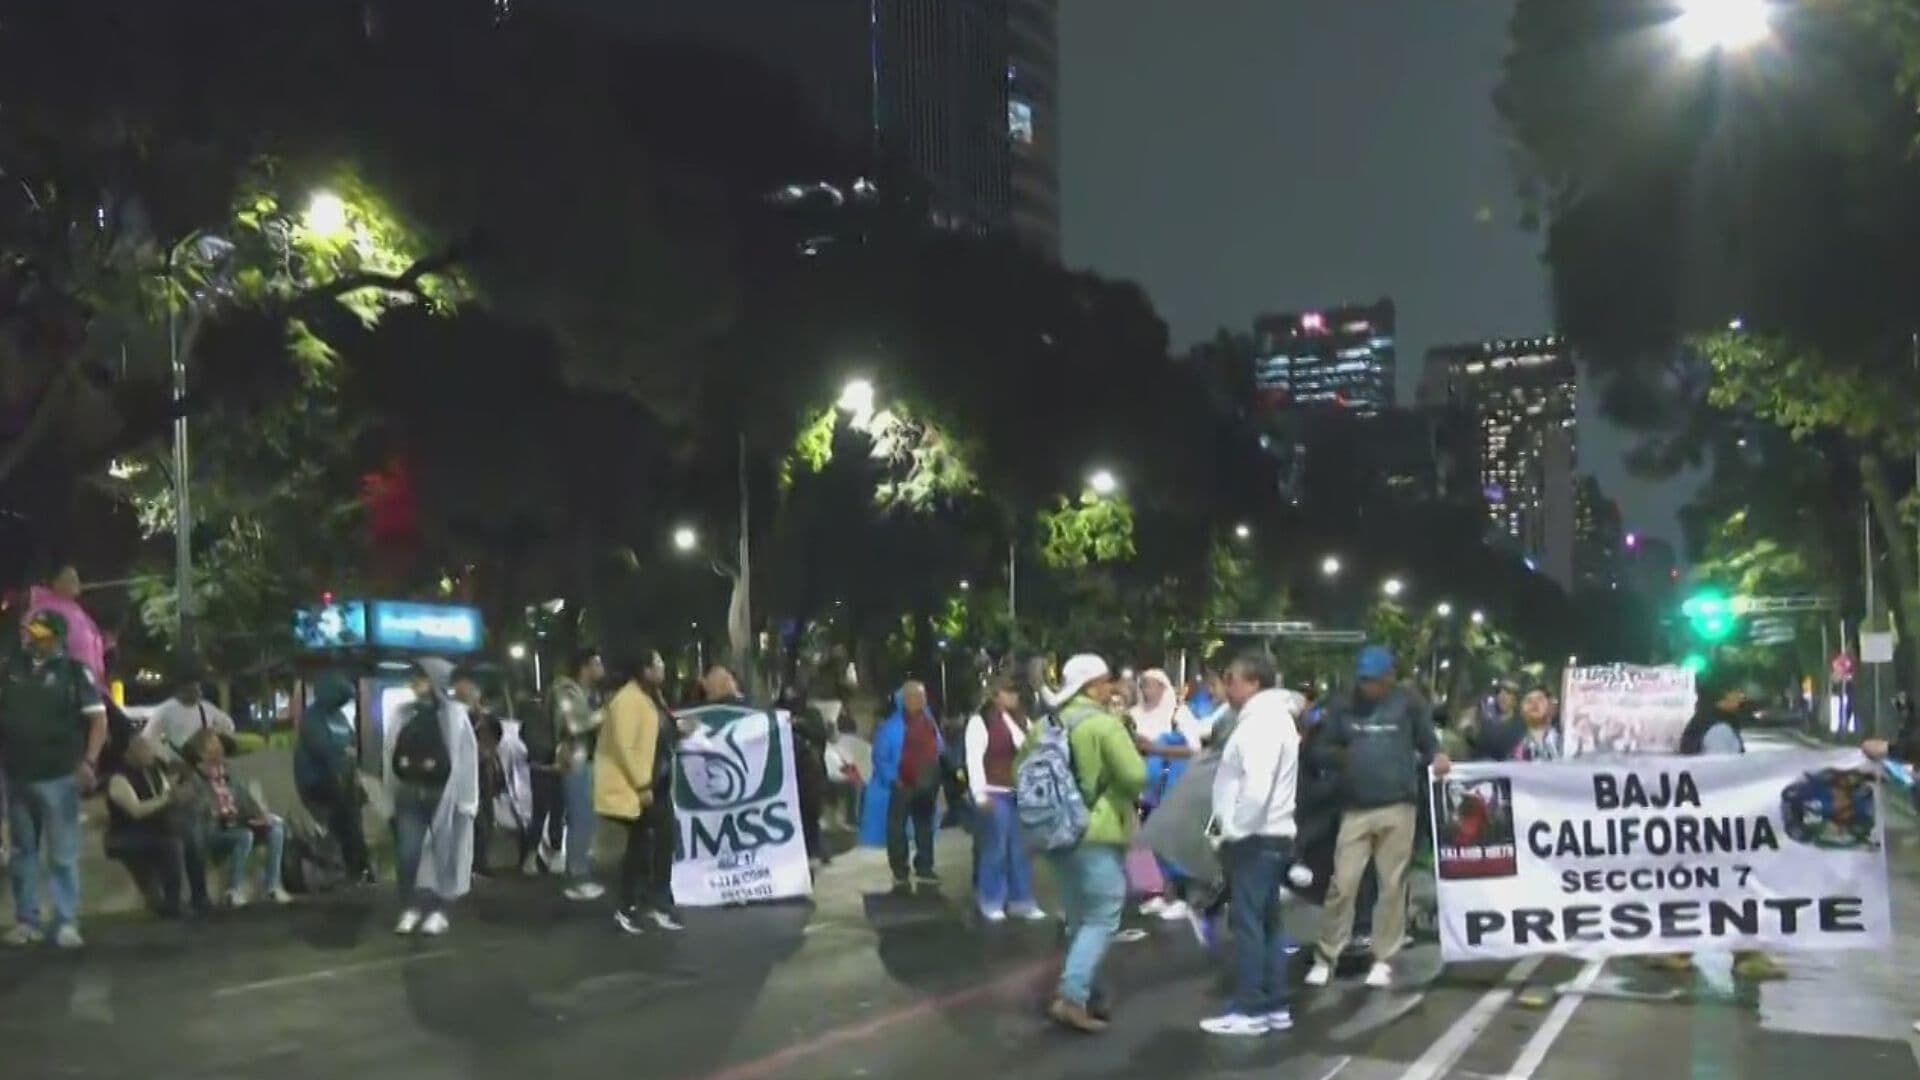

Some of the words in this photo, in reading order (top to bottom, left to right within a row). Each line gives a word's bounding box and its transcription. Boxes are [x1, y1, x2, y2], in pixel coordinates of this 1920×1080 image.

[1593, 771, 1701, 810] BAJA
[674, 801, 794, 862] IMSS
[1528, 815, 1778, 858] CALIFORNIA
[1561, 863, 1720, 894] SECCIÓN
[1732, 865, 1752, 888] 7
[1466, 897, 1865, 945] PRESENTE
